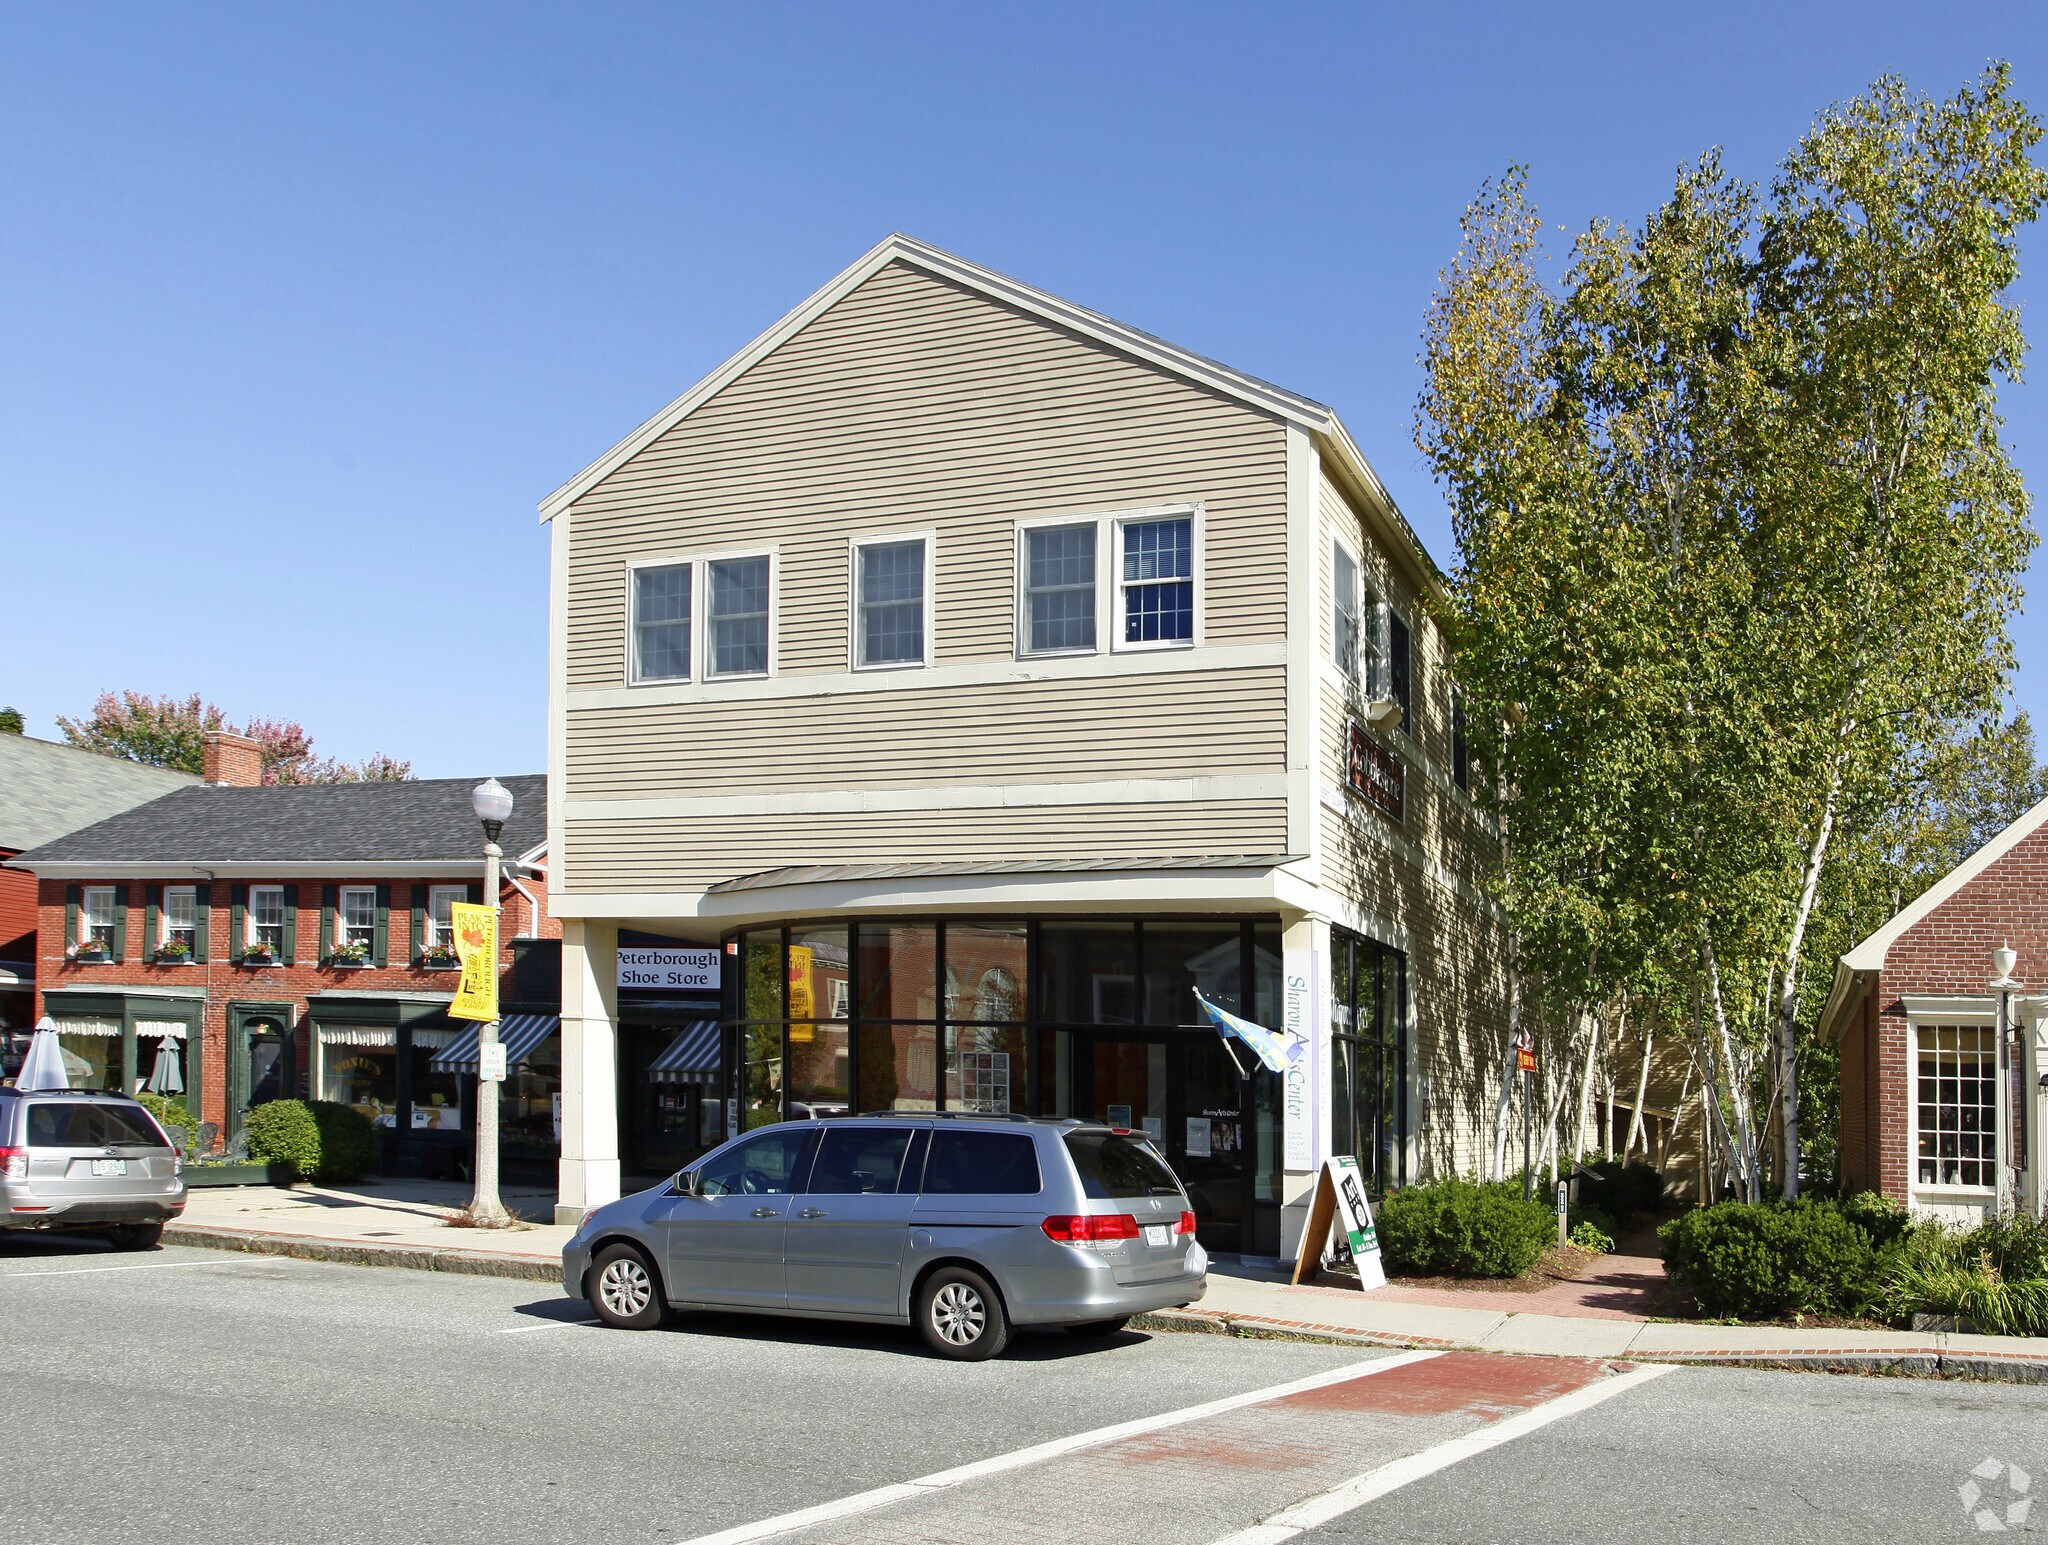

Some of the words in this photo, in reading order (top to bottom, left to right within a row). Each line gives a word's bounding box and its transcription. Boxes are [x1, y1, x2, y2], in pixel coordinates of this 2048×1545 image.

[457, 912, 483, 923] PEAK
[458, 921, 486, 931] INTO
[483, 915, 493, 997] PETERBOROUGH
[617, 951, 718, 969] Peterborough
[622, 970, 660, 984] Shoe
[667, 971, 708, 985] Store
[1287, 975, 1307, 1029] Sharon
[1287, 1069, 1306, 1120] Center
[1344, 1178, 1358, 1202] Art
